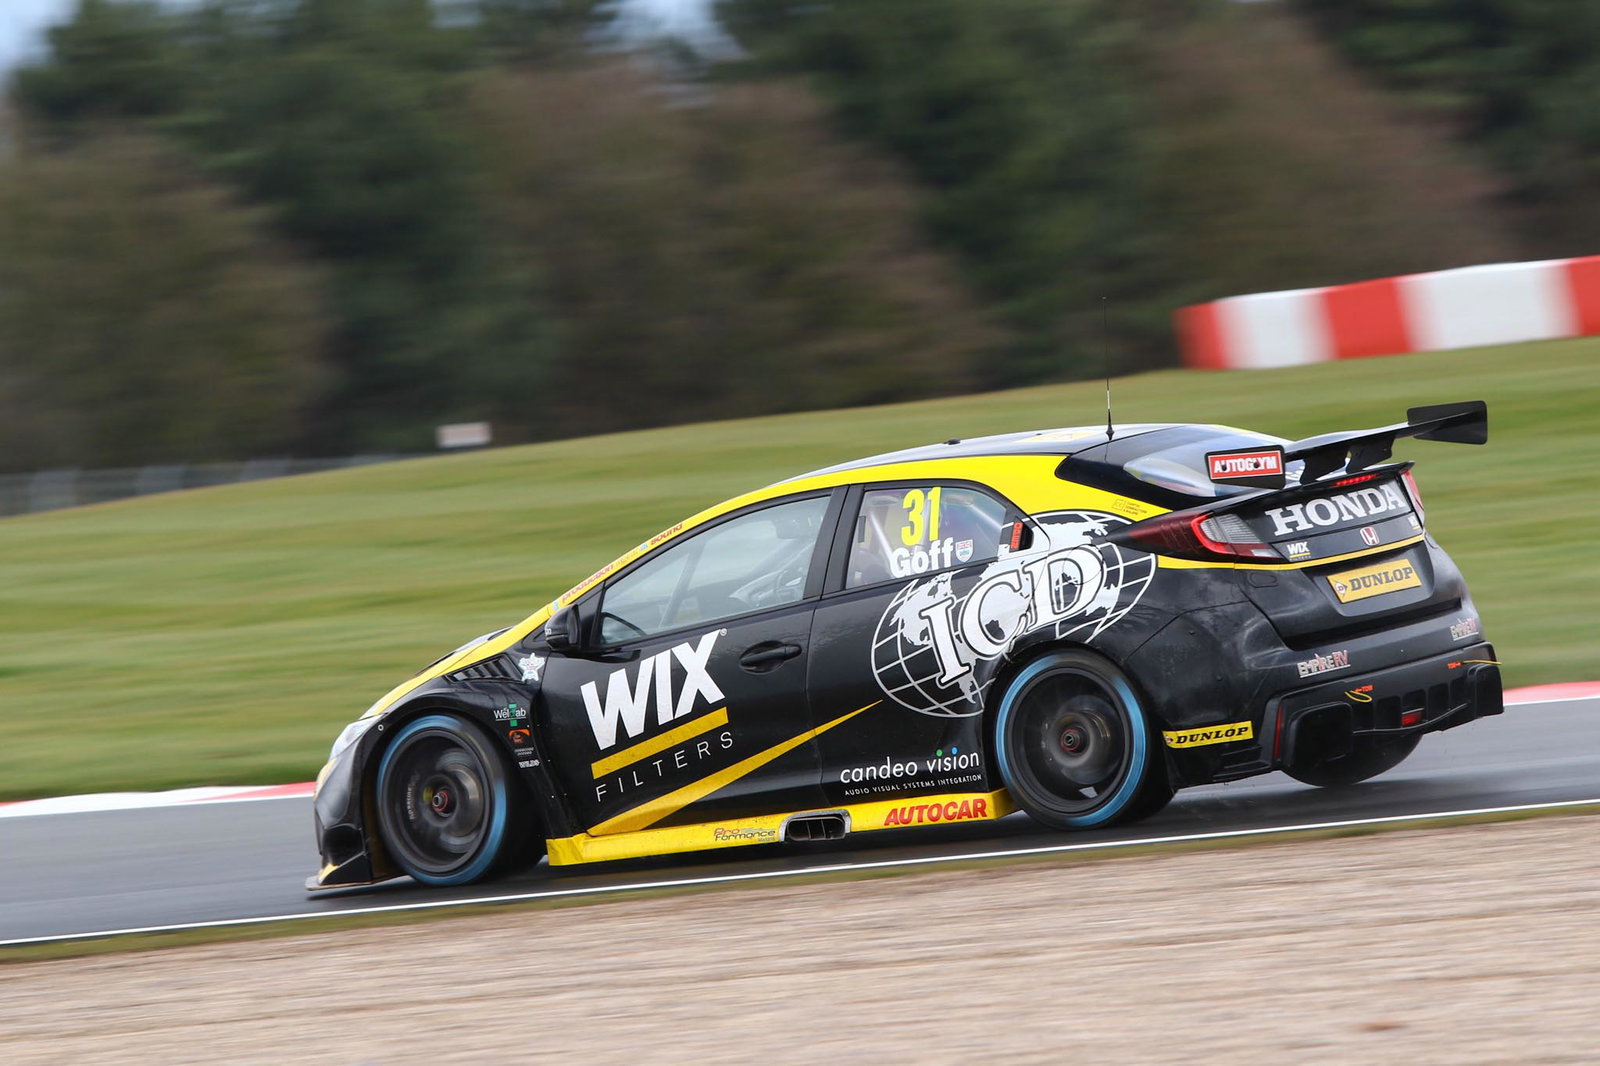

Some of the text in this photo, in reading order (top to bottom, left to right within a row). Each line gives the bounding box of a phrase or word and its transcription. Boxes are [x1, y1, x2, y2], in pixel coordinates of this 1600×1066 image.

[901, 486, 942, 546] 31
[1264, 484, 1407, 537] HONDA
[889, 537, 954, 579] Goff
[1286, 541, 1310, 555] WIX
[1349, 566, 1414, 592] DUNLOP
[918, 543, 1107, 688] ICD
[580, 628, 726, 751] WIX
[1175, 726, 1249, 745] DUNLOP
[595, 730, 734, 803] FILTERS
[840, 746, 980, 784] candeo vision
[844, 773, 983, 797] AUDIO VISUAL SYSTEMS INTEGRATION
[883, 798, 988, 827] AUTOCAR
